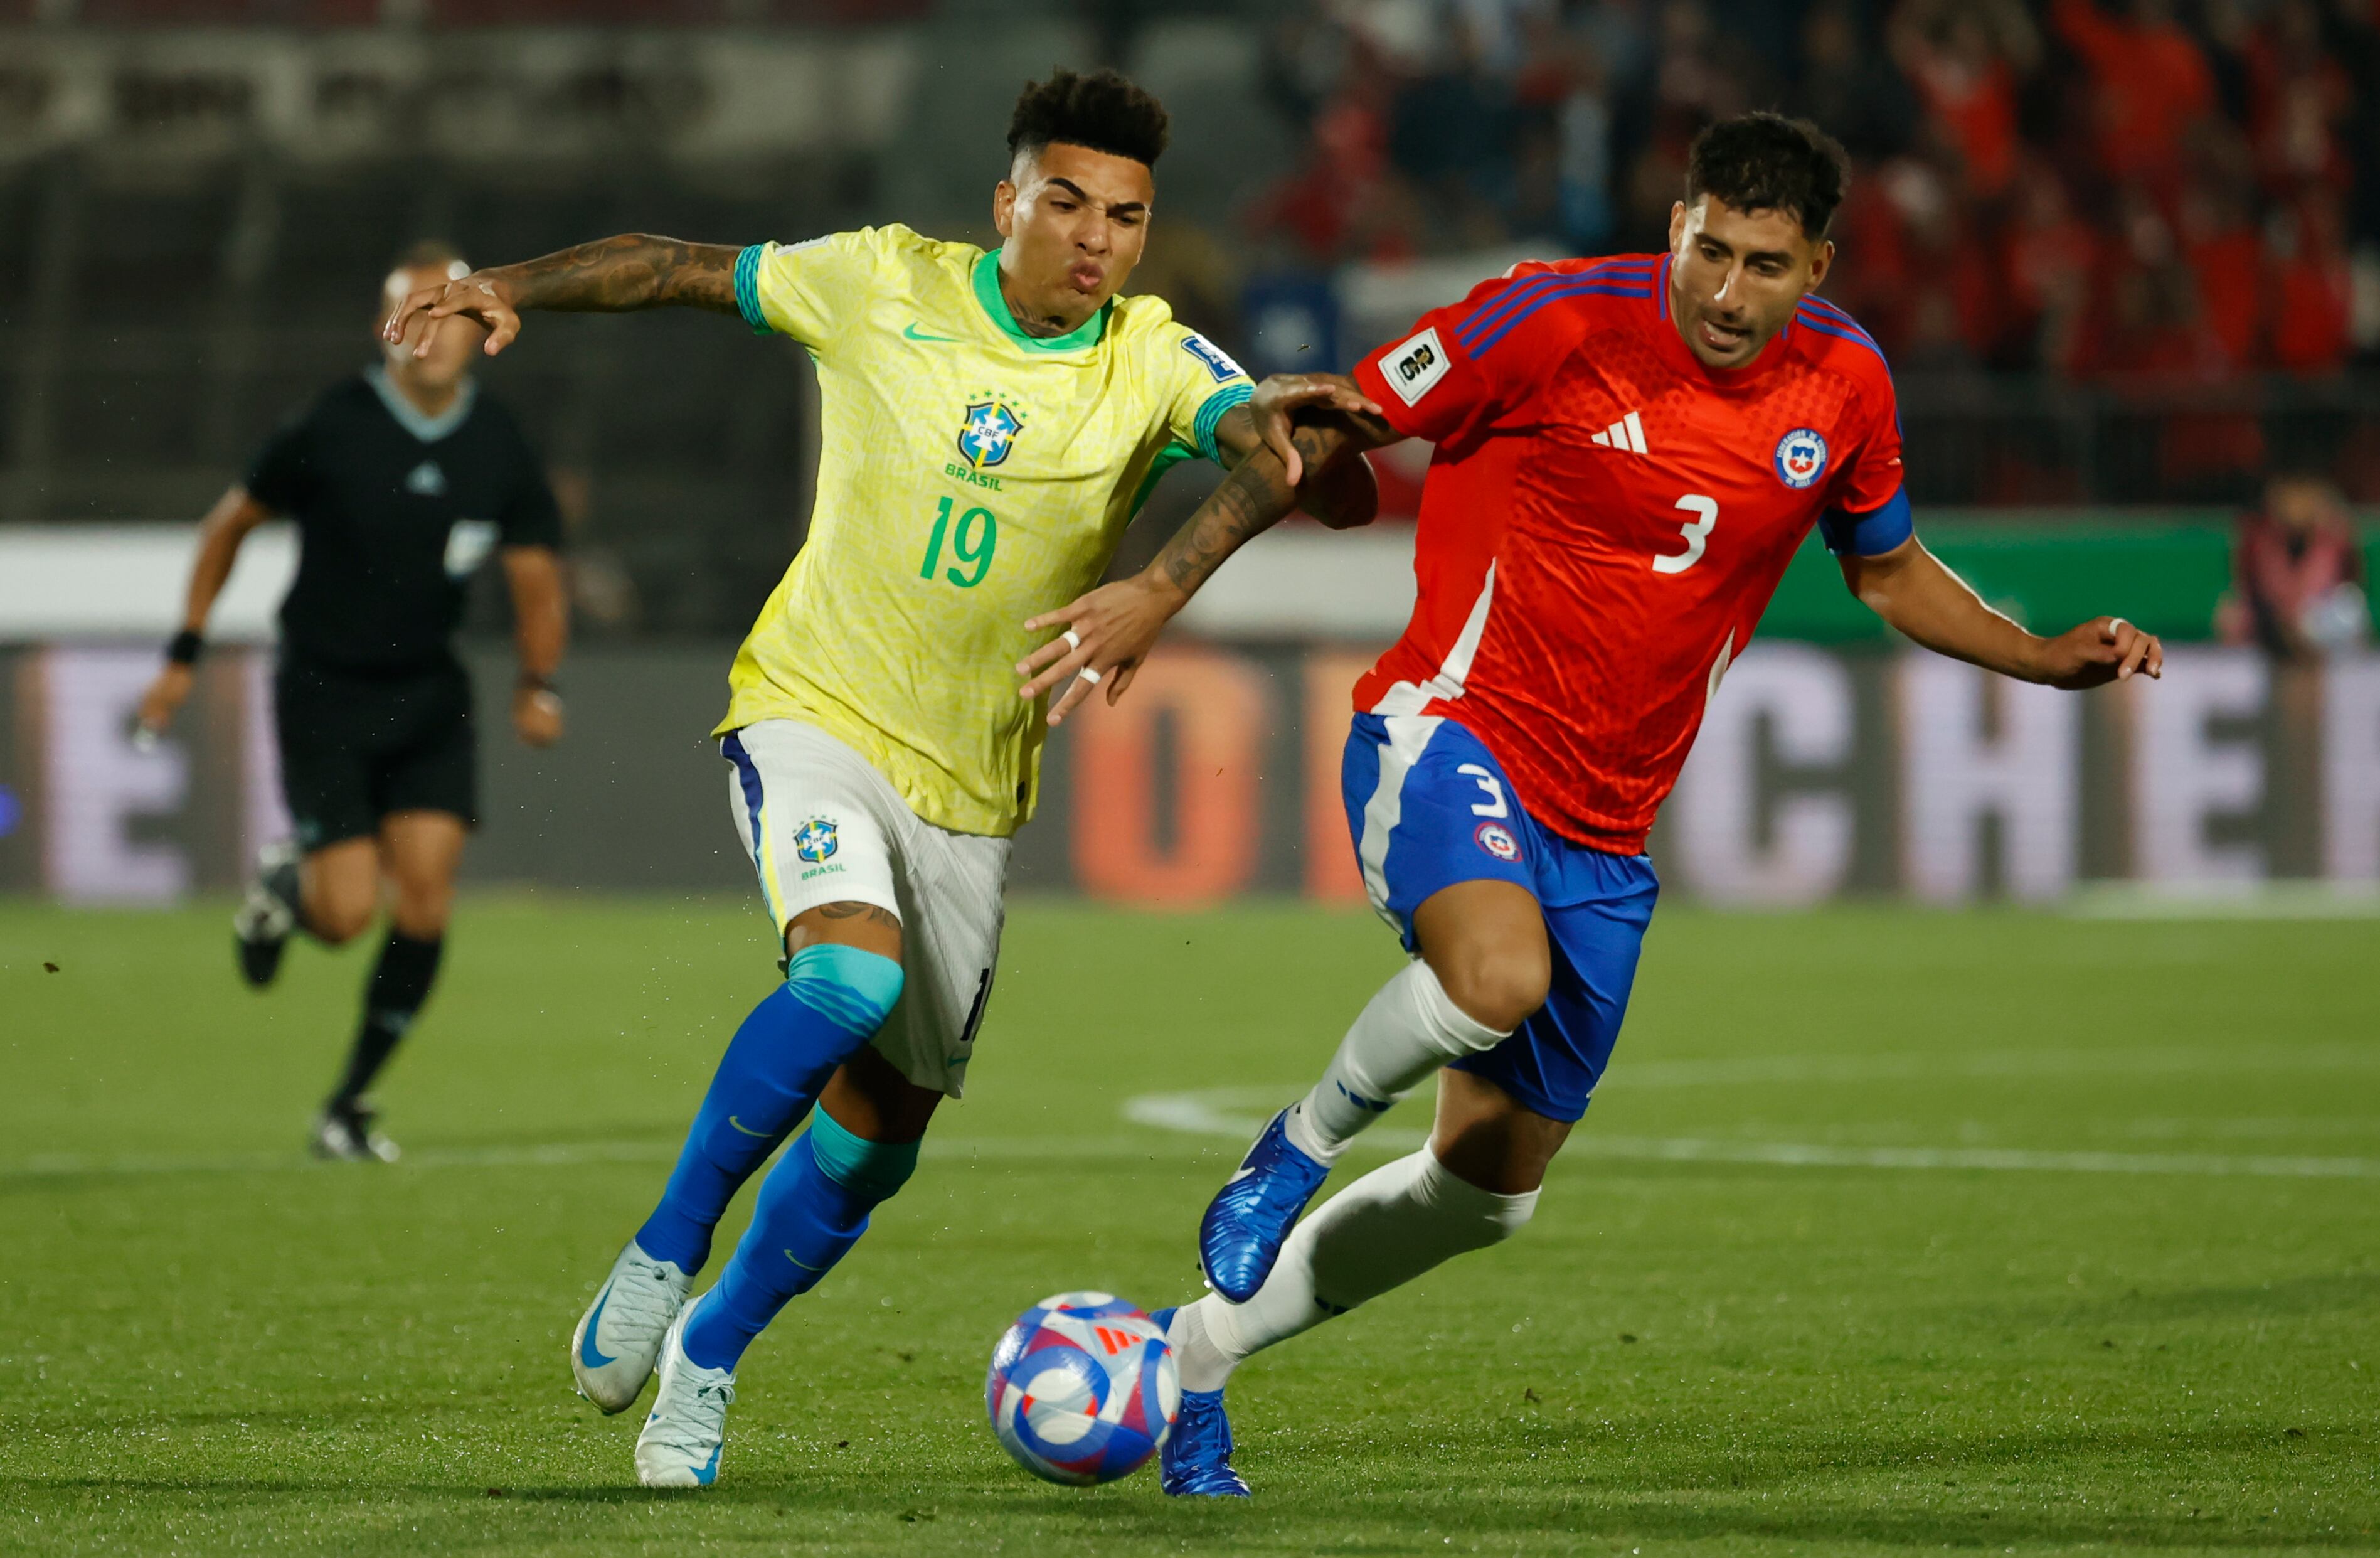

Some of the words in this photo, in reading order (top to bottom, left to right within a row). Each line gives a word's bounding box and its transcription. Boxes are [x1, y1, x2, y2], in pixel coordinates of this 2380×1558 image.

[977, 425, 999, 438] CBF
[945, 463, 1003, 492] BRASIL
[920, 496, 997, 588] 19
[1652, 493, 1718, 574] 3
[1457, 763, 1508, 818] 3
[801, 863, 847, 880] BRASIL
[960, 968, 993, 1044] 1
